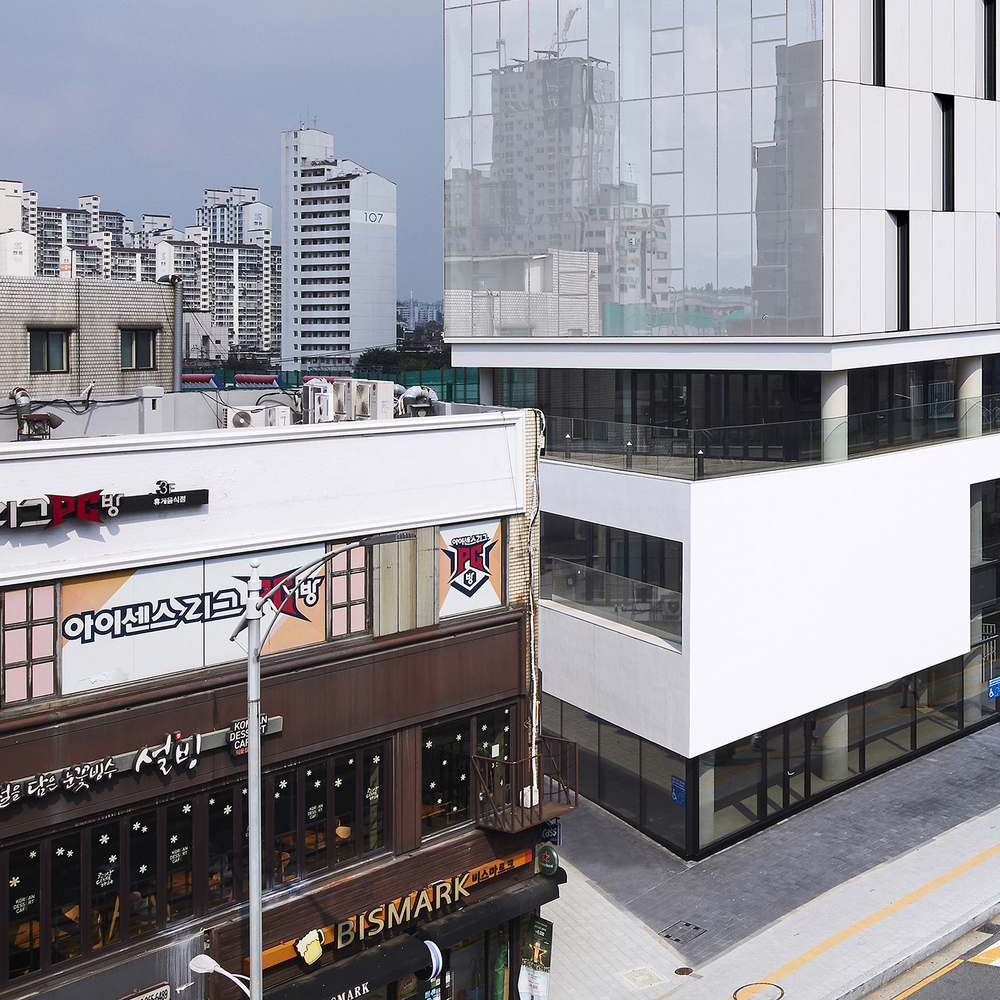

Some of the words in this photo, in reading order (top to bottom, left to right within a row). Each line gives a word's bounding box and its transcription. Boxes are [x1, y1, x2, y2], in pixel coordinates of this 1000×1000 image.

[364, 212, 384, 223] 107
[234, 714, 268, 732] KORN
[230, 724, 267, 742] DESST
[234, 738, 249, 750] CAF
[134, 732, 201, 775] 설빙
[28, 775, 58, 796] 담은
[63, 758, 118, 793] 눈꽃빙수
[336, 871, 471, 950] BISMARK
